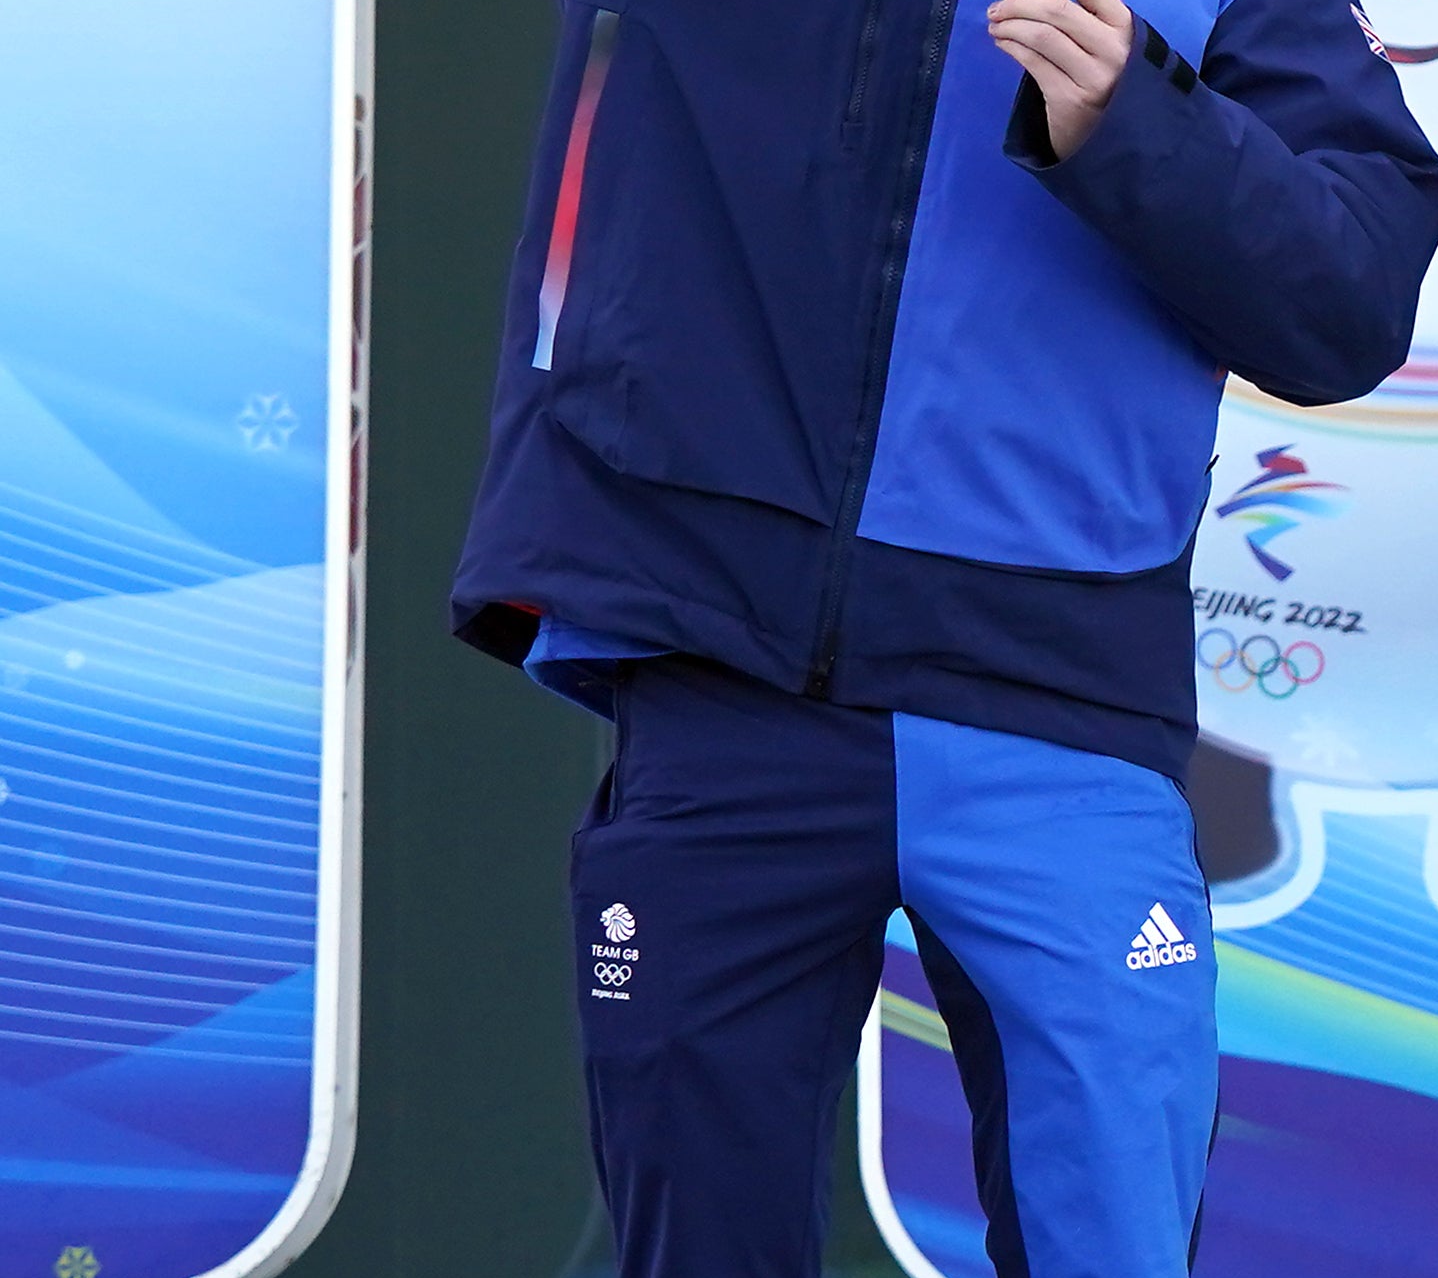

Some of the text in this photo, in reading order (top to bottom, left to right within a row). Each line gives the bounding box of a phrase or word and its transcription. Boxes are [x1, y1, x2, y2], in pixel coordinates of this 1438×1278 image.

[1193, 586, 1370, 634] EIJING 2022
[591, 944, 639, 961] TEAM GB
[1125, 941, 1197, 971] adidas
